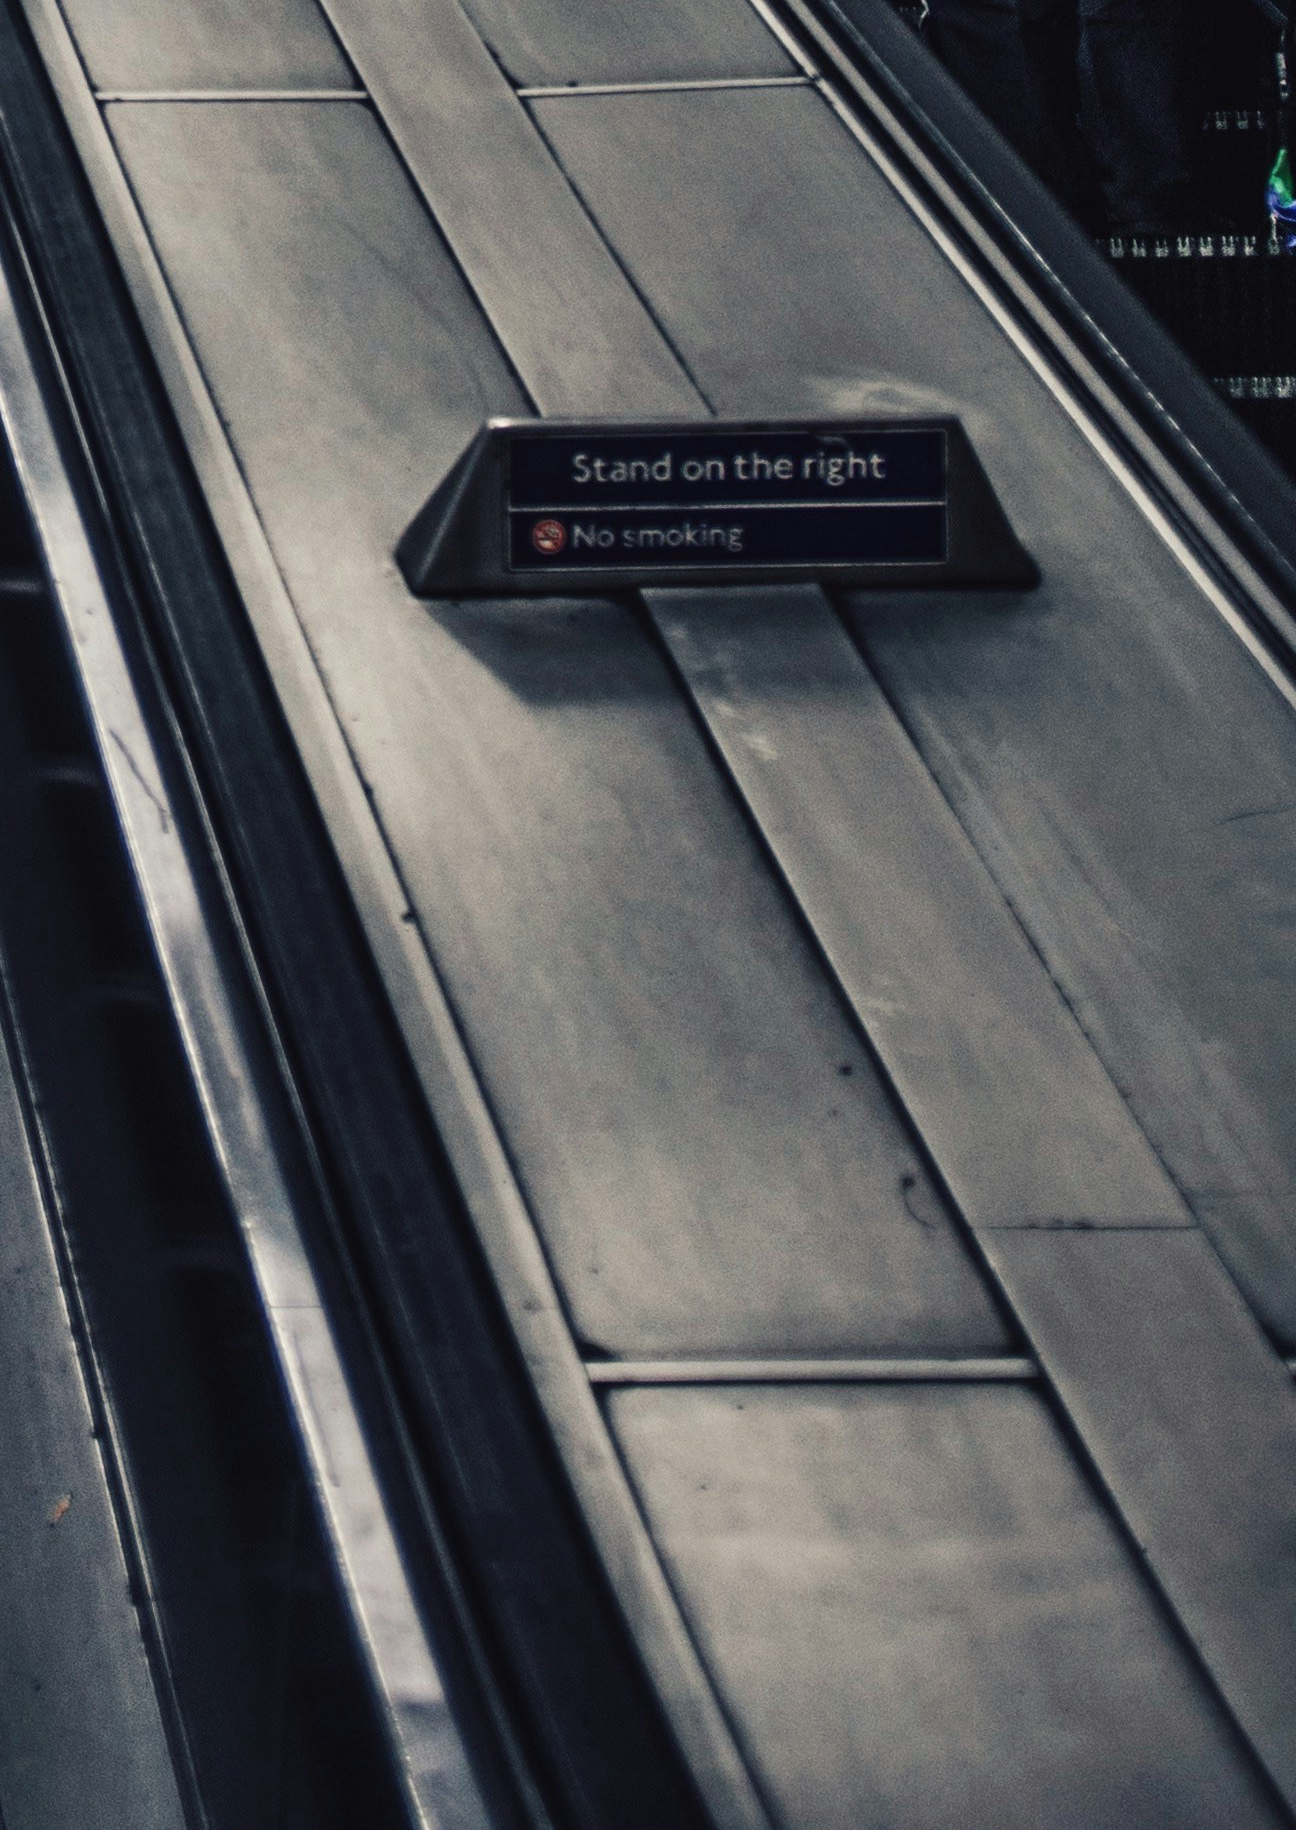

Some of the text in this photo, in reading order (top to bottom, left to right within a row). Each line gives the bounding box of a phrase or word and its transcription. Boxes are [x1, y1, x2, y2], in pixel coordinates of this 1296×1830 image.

[572, 450, 887, 488] Stand on the right
[572, 522, 744, 551] No smoking
